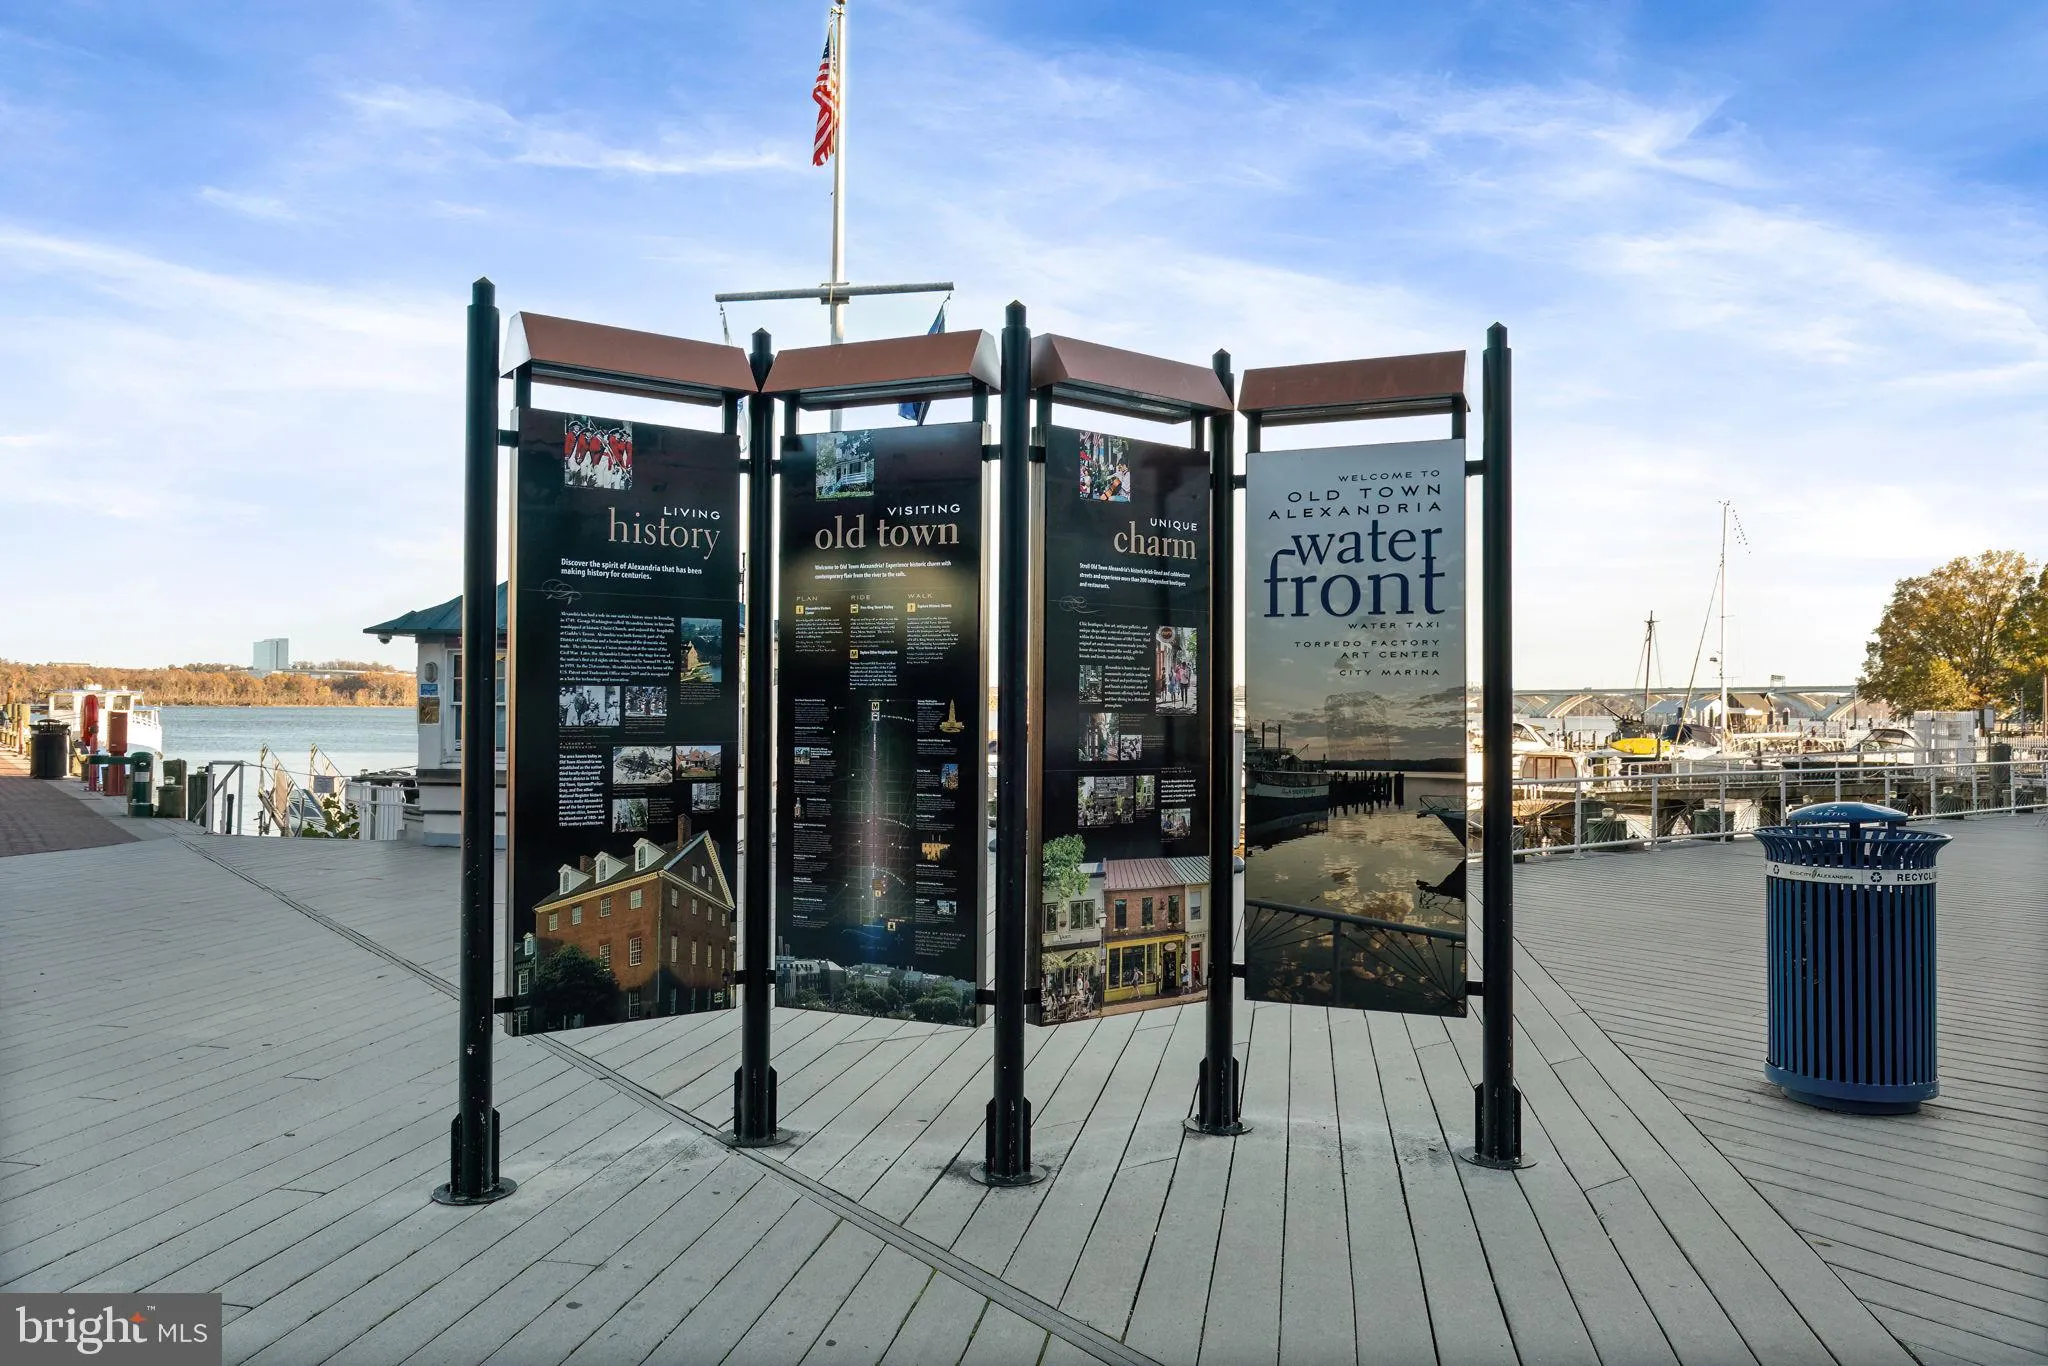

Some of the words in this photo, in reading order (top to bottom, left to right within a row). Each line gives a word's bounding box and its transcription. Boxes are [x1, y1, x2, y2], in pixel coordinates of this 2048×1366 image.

[1338, 471, 1412, 482] WELCOME
[1288, 490, 1340, 502] OLD
[1360, 484, 1441, 499] TOWN
[664, 506, 720, 520] LIVING
[887, 504, 961, 516] VISITING
[1268, 502, 1441, 520] ALEXANDRIA
[608, 506, 720, 560] history
[815, 514, 866, 550] old
[877, 519, 960, 547] town
[1150, 518, 1198, 531] UNIQUE
[1114, 520, 1197, 560] charm
[1292, 520, 1442, 566] water
[561, 558, 588, 567] Discover
[589, 560, 600, 568] the
[601, 561, 619, 571] spirit
[620, 562, 627, 570] of
[627, 563, 660, 572] Alexandria
[676, 566, 686, 574] has
[561, 568, 586, 577] making
[587, 568, 609, 578] history
[621, 572, 652, 580] centuries.
[1264, 548, 1445, 617] front
